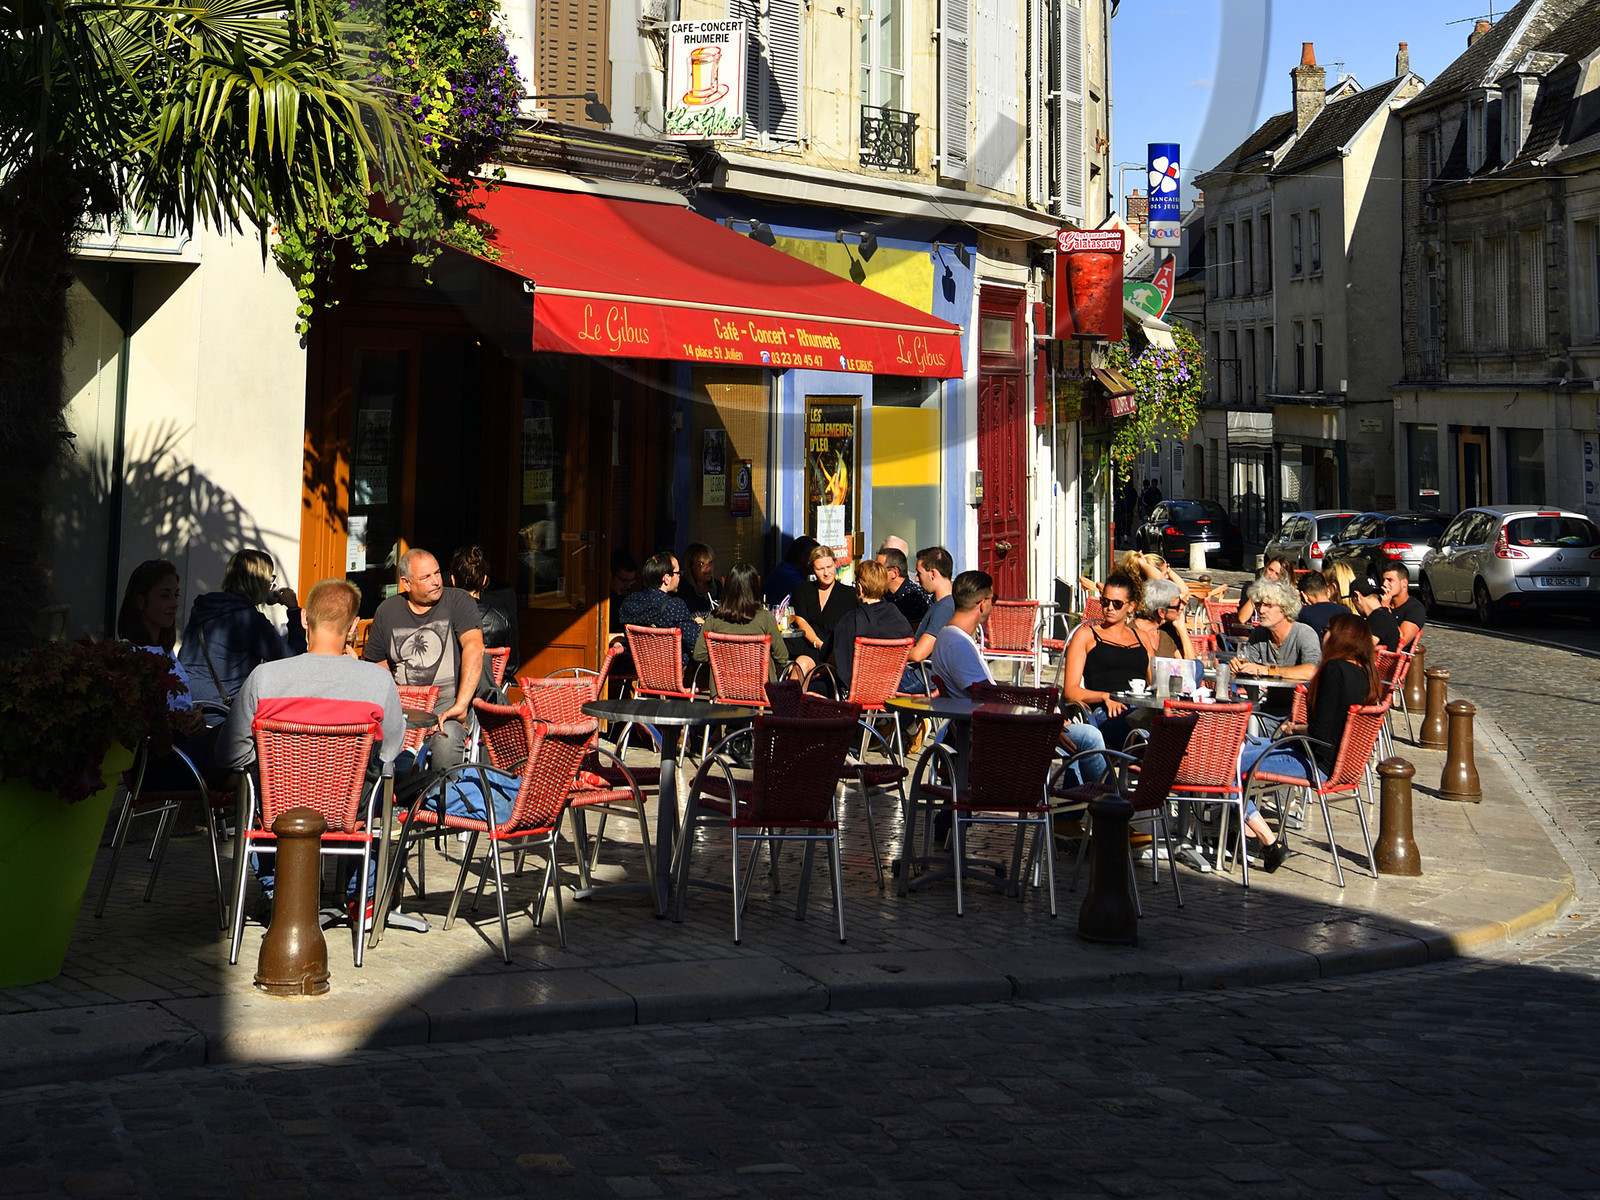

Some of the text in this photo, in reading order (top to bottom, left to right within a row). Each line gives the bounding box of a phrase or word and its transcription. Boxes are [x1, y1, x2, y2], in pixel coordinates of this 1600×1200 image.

[671, 21, 743, 34] CAFE-CONCERT
[684, 33, 730, 44] RHUMERIE
[1059, 232, 1121, 251] Galatasaray
[578, 303, 650, 352] Le Gibus
[714, 317, 740, 341] Café
[748, 321, 788, 345] Concert
[796, 328, 842, 350] Rhumerie
[683, 344, 744, 361] 14 place St Julien
[771, 351, 823, 367] 03 23 20 45 47
[896, 334, 947, 373] Le Gibus
[846, 358, 874, 372] LE GIBUS
[810, 408, 823, 423] LES
